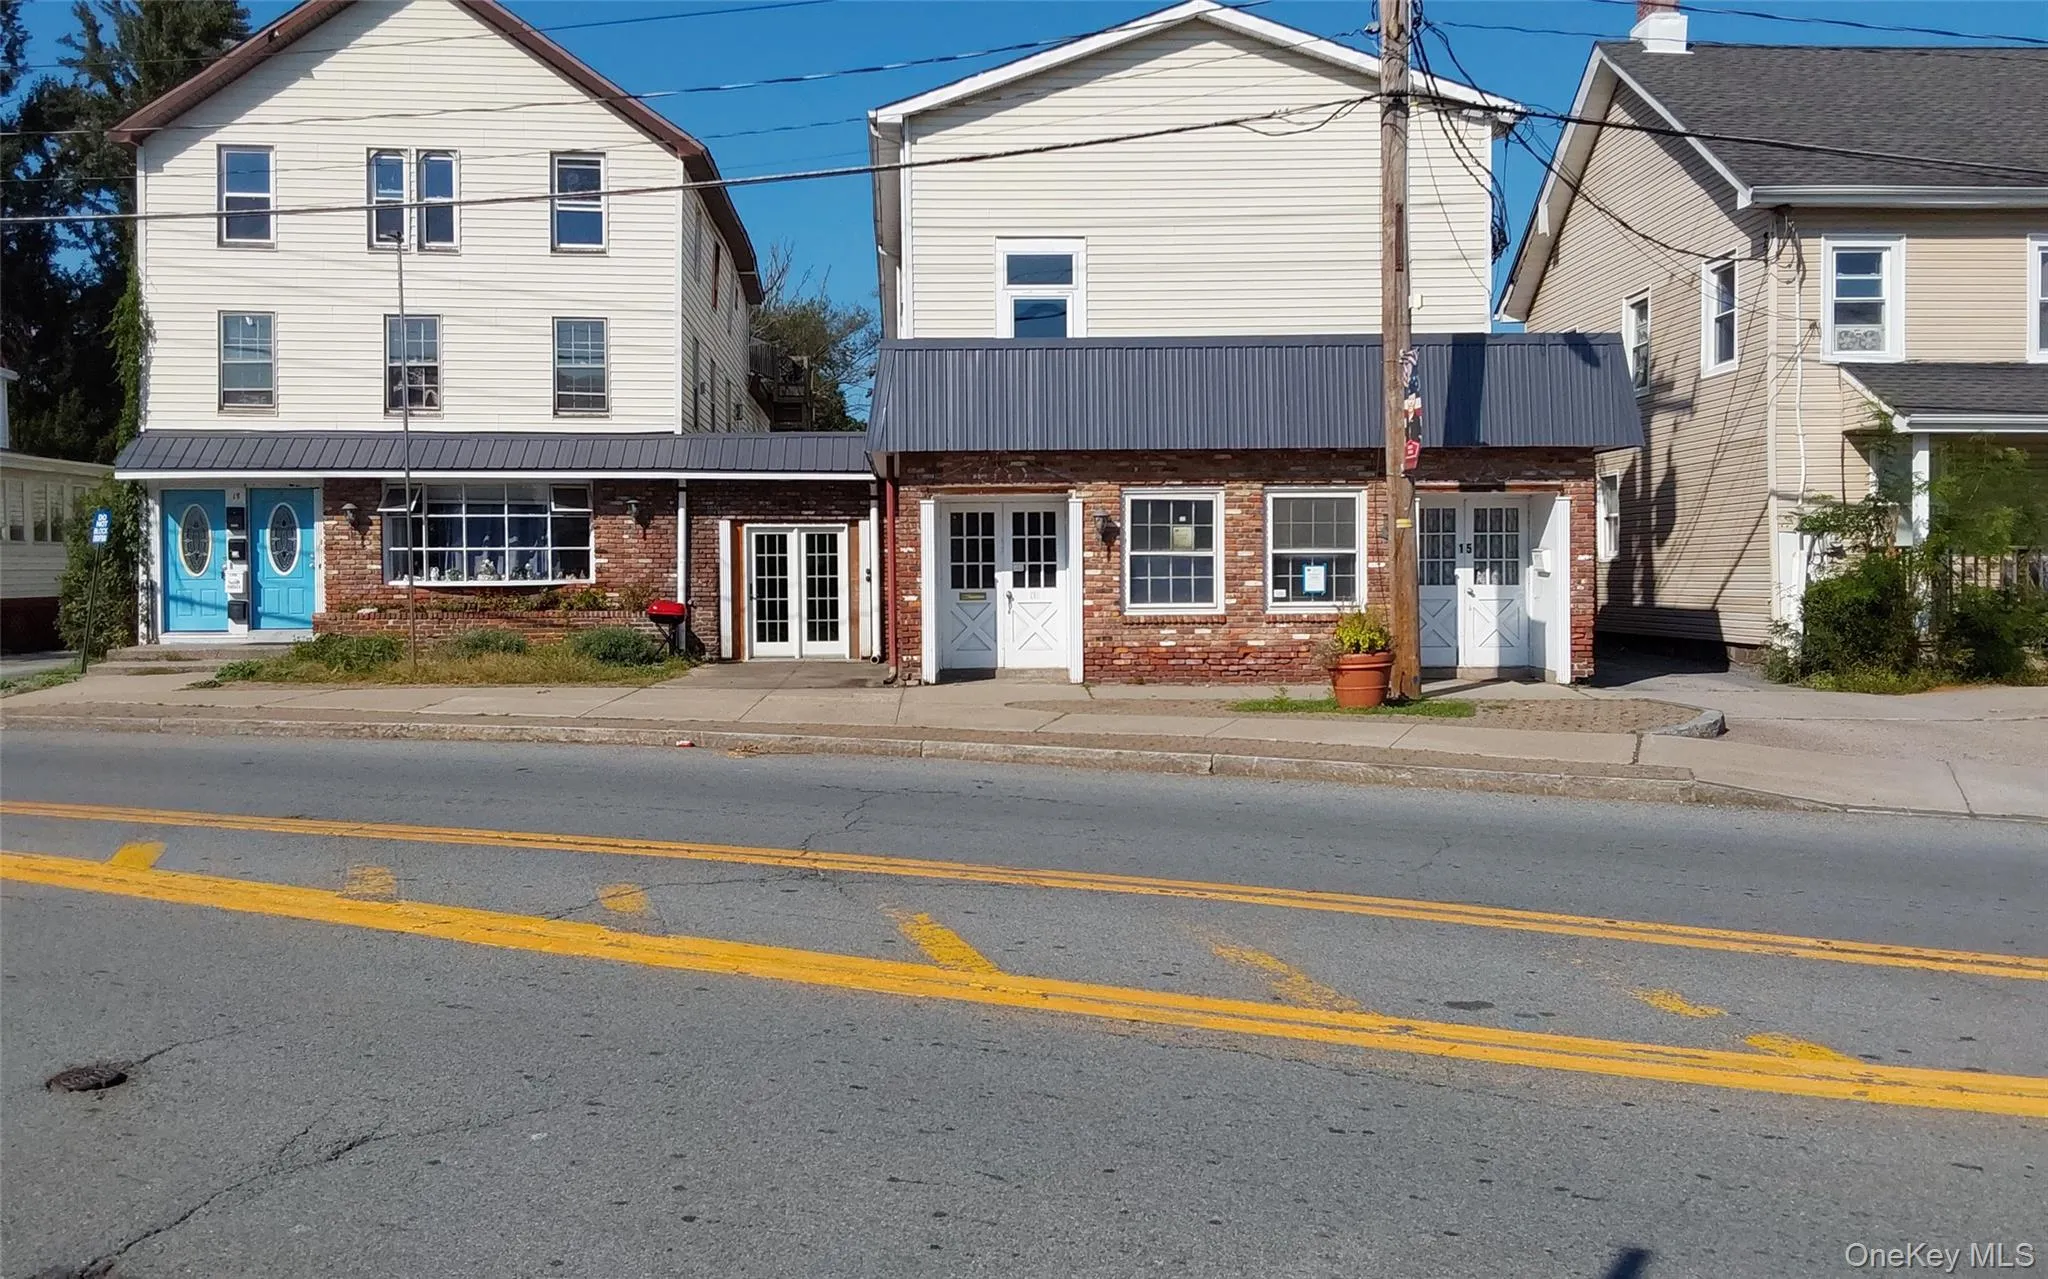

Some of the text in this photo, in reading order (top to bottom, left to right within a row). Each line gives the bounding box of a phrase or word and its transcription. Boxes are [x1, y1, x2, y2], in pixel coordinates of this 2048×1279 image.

[98, 513, 107, 521] DO
[95, 520, 108, 528] NOT
[93, 527, 108, 535] BLOCK
[1458, 543, 1472, 553] 15
